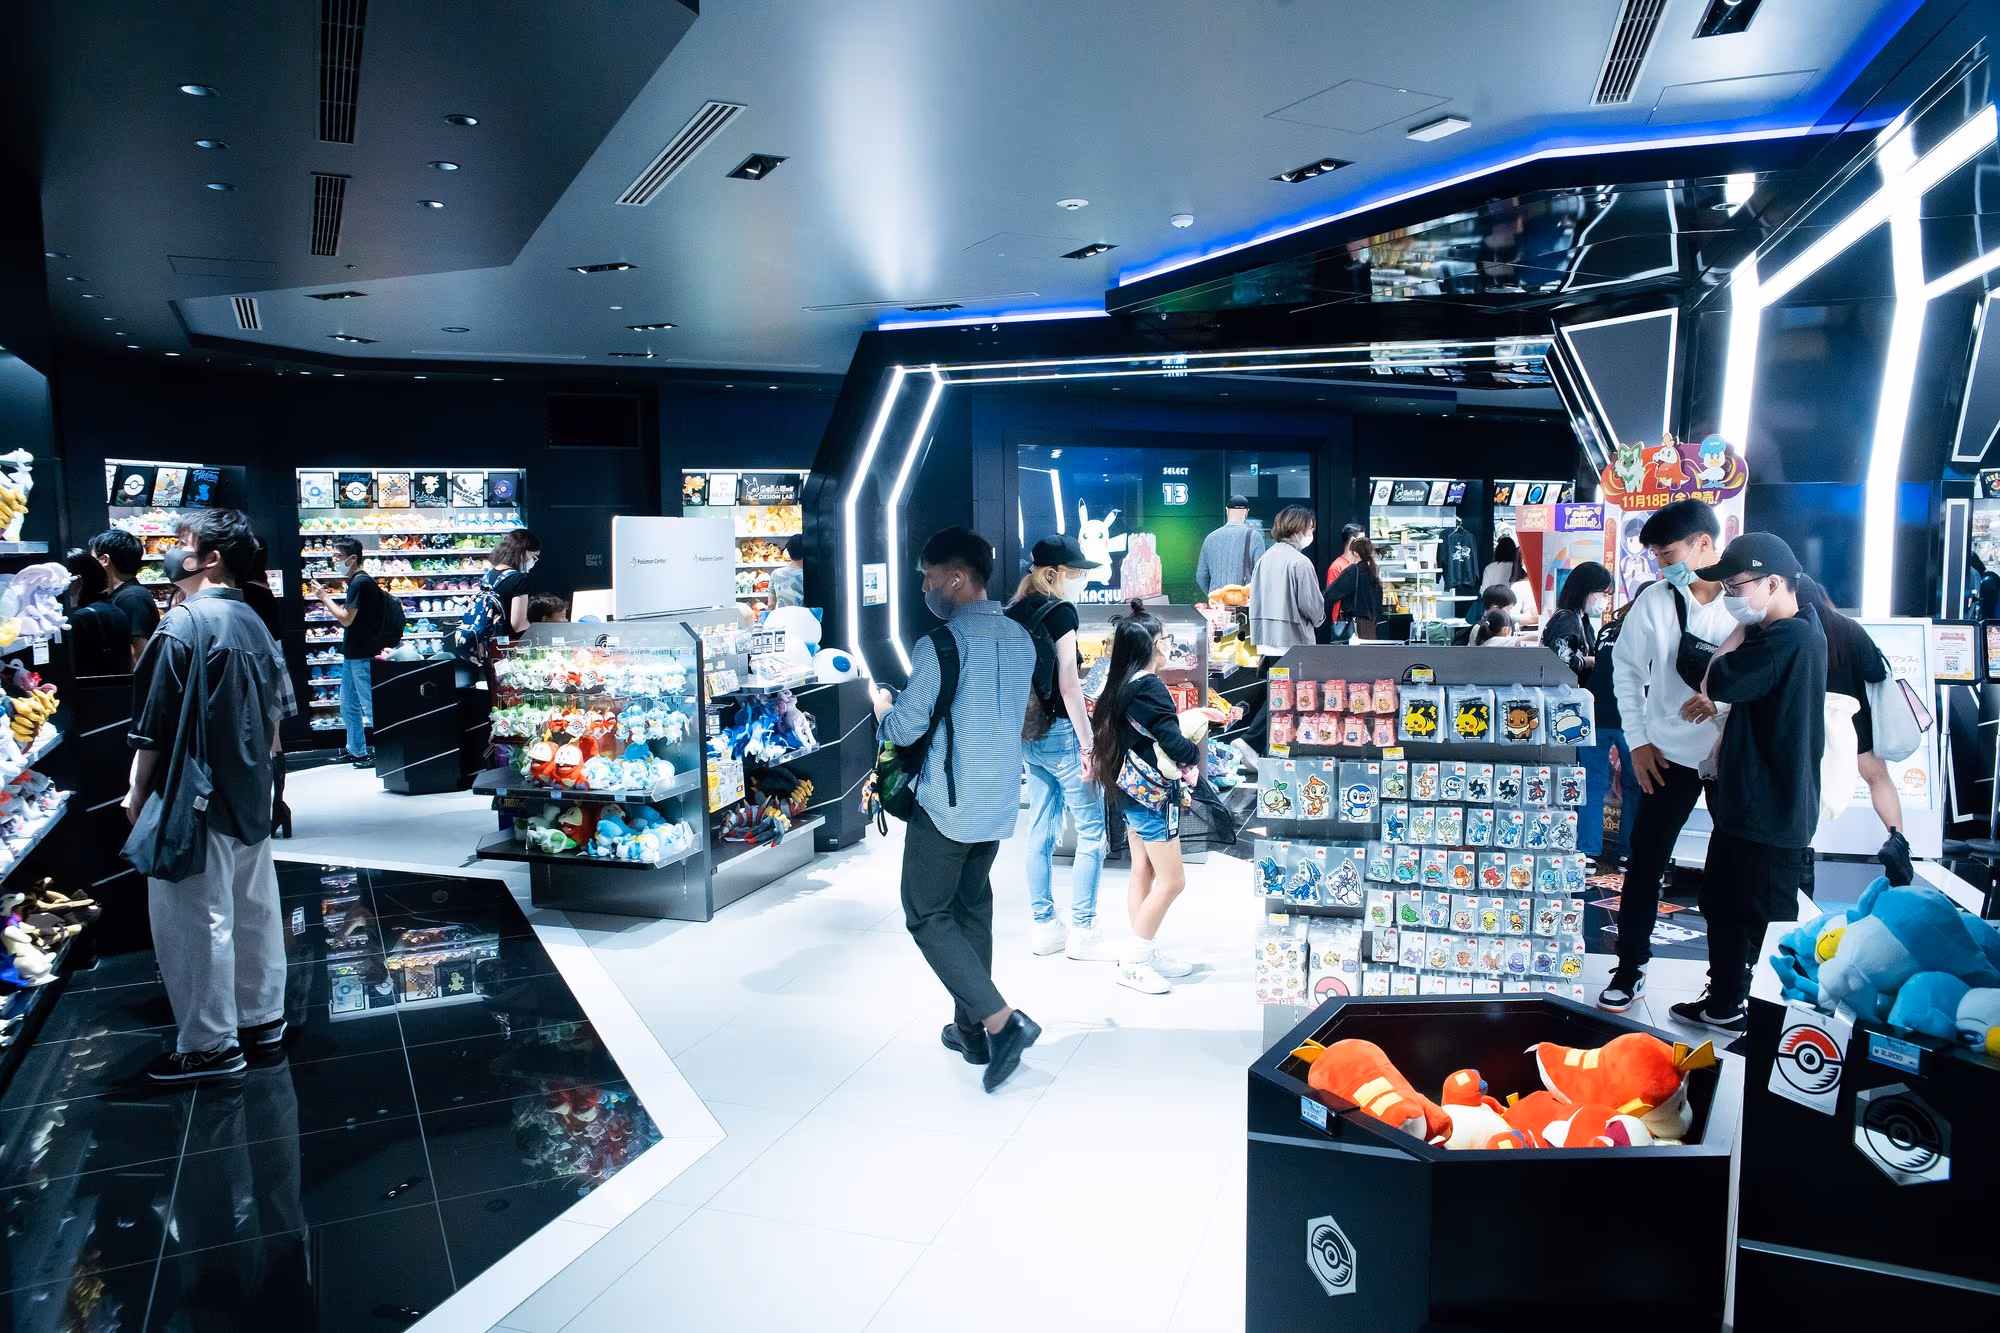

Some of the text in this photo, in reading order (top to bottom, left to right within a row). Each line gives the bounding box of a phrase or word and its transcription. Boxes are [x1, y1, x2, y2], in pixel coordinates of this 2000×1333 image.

[1163, 467, 1189, 475] SELECT
[1163, 483, 1189, 505] 13
[1881, 1050, 1903, 1062] 2,200
